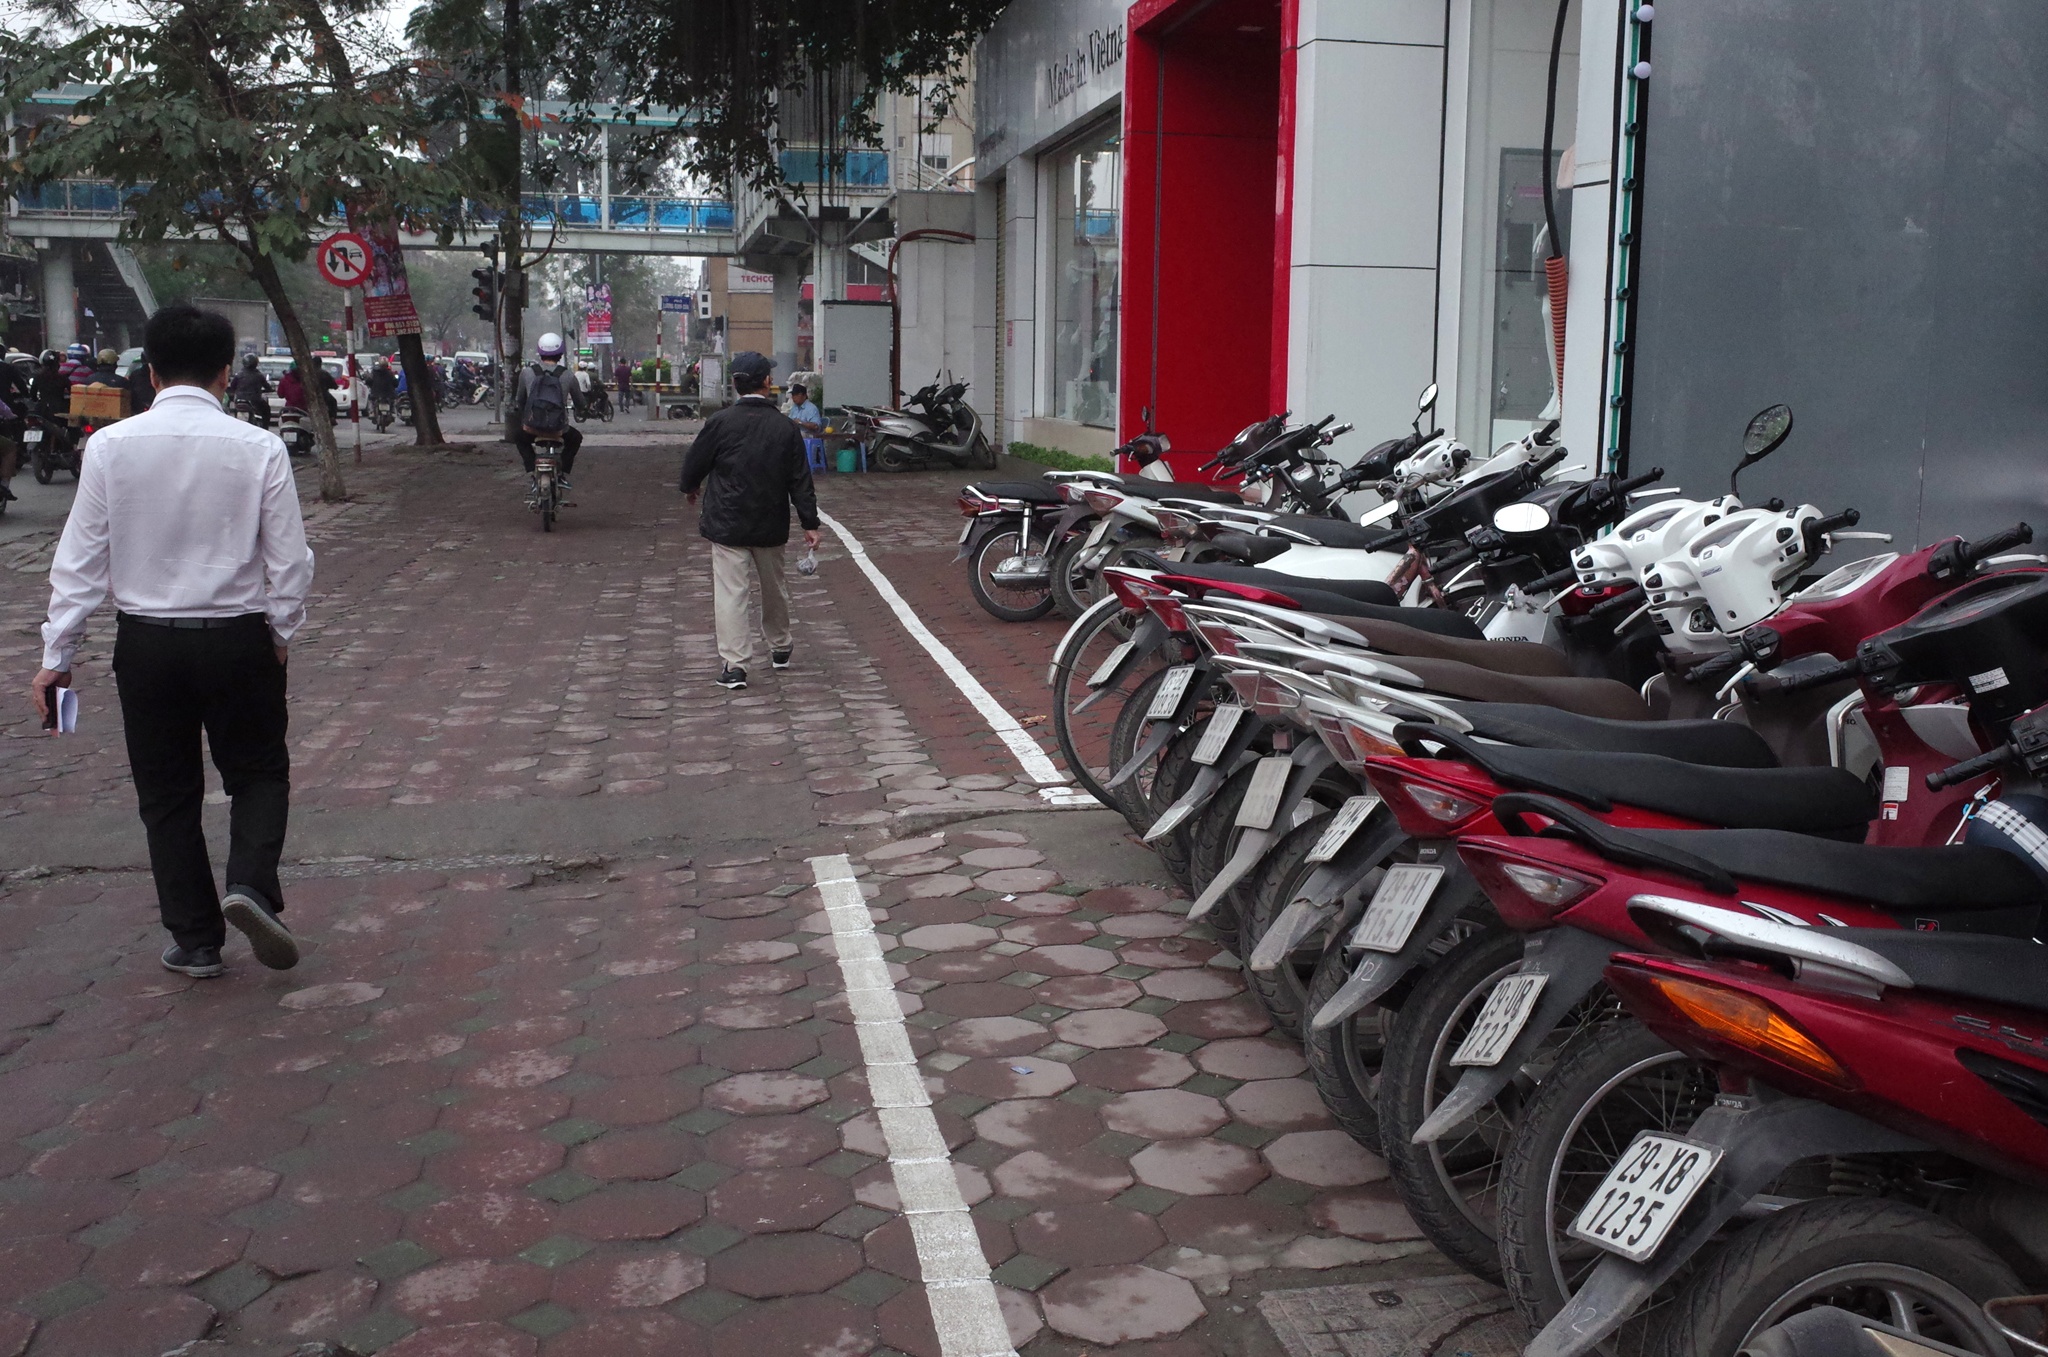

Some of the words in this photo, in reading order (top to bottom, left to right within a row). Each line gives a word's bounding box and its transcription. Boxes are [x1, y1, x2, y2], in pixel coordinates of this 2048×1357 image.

[1047, 53, 1075, 108] Made
[1076, 47, 1087, 88] in
[1380, 870, 1433, 906] 29-H1
[1357, 907, 1416, 946] 515.41
[1479, 978, 1535, 1022] 29-U8
[1616, 1140, 1700, 1195] 29-X8
[1586, 1187, 1665, 1246] 1235
